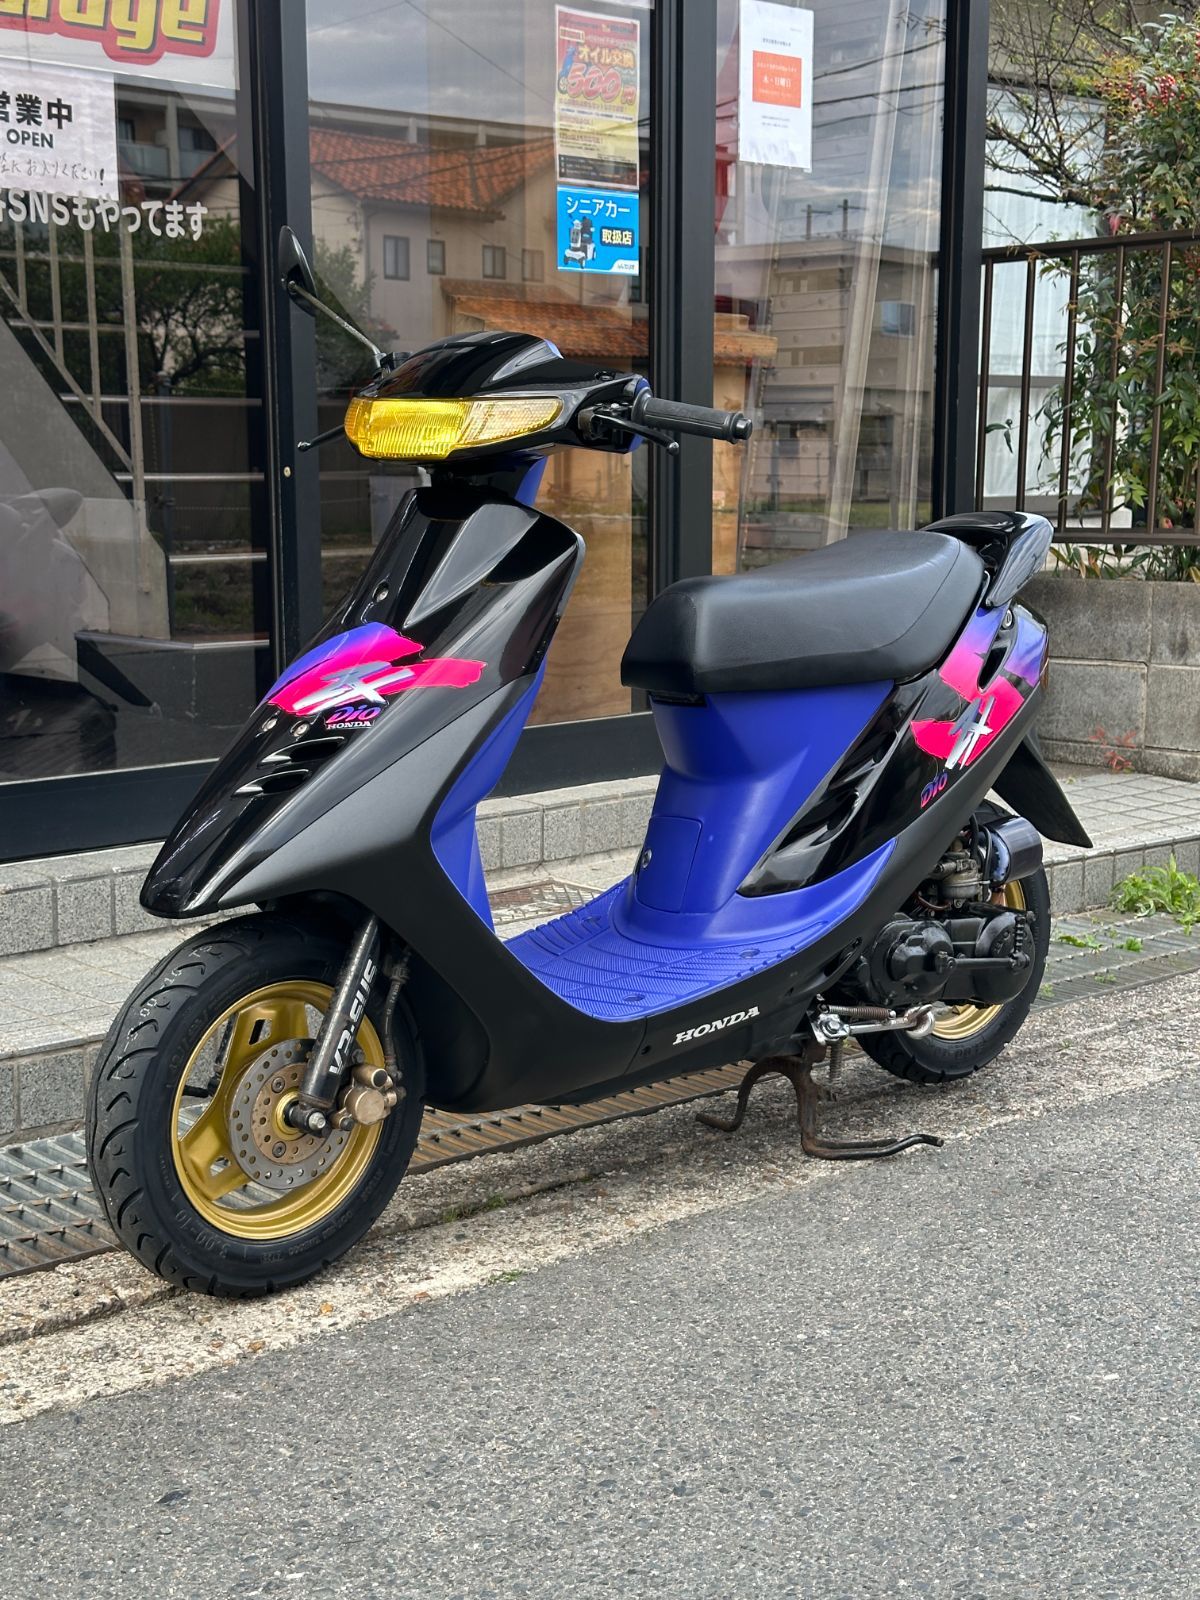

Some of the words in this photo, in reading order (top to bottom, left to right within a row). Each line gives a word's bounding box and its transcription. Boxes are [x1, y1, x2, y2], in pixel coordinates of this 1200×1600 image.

[6, 128, 54, 149] OPEN
[0, 187, 208, 242] SNSもやってます
[565, 196, 631, 218] シニアカー
[601, 228, 632, 246] 取扱店
[325, 704, 381, 724] Dio
[326, 720, 373, 730] HONDA
[920, 770, 948, 808] Dio
[672, 1006, 760, 1046] HONDA
